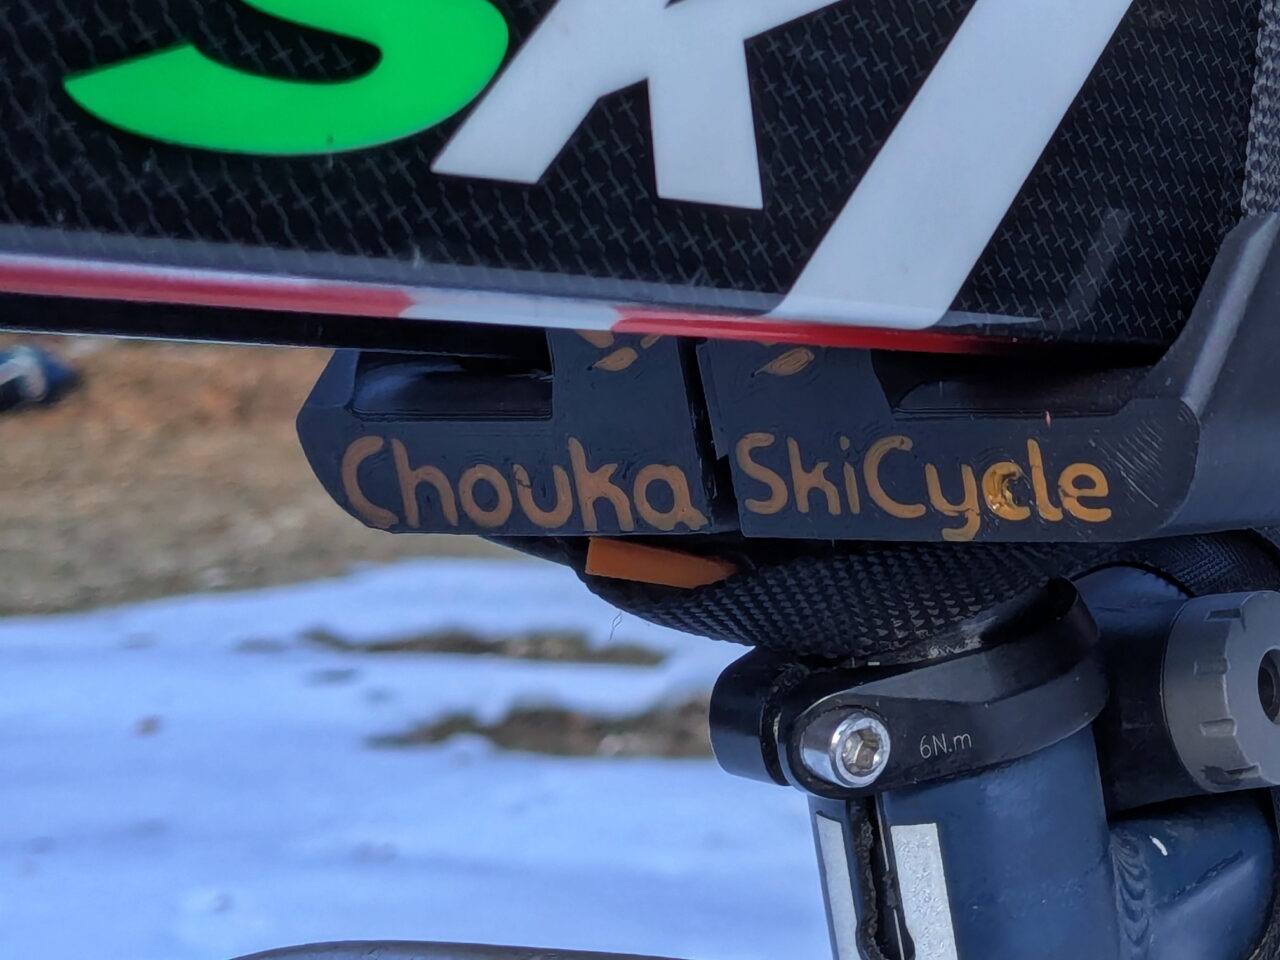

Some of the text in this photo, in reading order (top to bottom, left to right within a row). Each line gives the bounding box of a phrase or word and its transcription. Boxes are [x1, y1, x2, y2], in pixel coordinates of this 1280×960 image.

[342, 432, 1112, 542] Chouka SkiCycle
[919, 732, 973, 759] 6N.m
